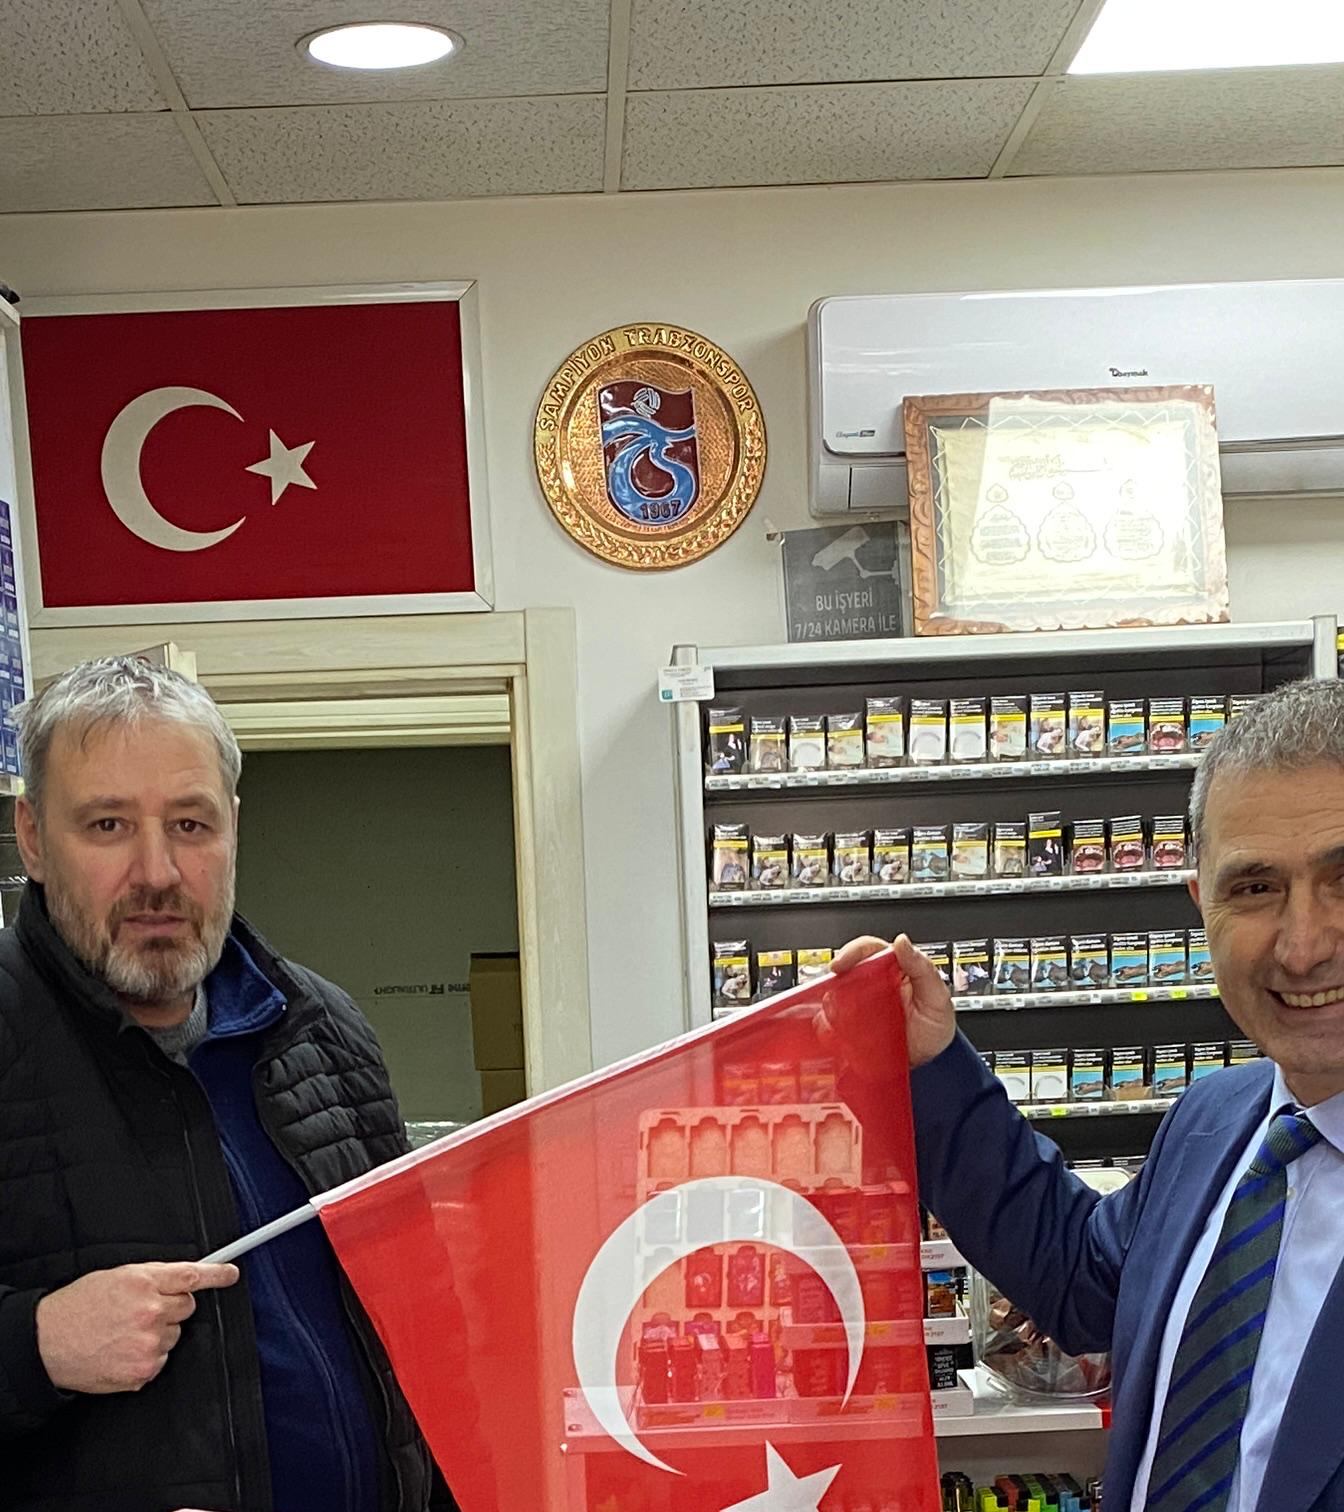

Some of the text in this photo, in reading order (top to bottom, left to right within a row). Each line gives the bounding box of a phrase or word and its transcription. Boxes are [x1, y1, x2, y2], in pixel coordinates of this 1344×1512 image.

[624, 327, 753, 412] TRABZONSPOR
[640, 500, 682, 520] 1967
[816, 588, 873, 611] BU İŞYERİ
[795, 616, 897, 639] 7/24 KAMERA İLE
